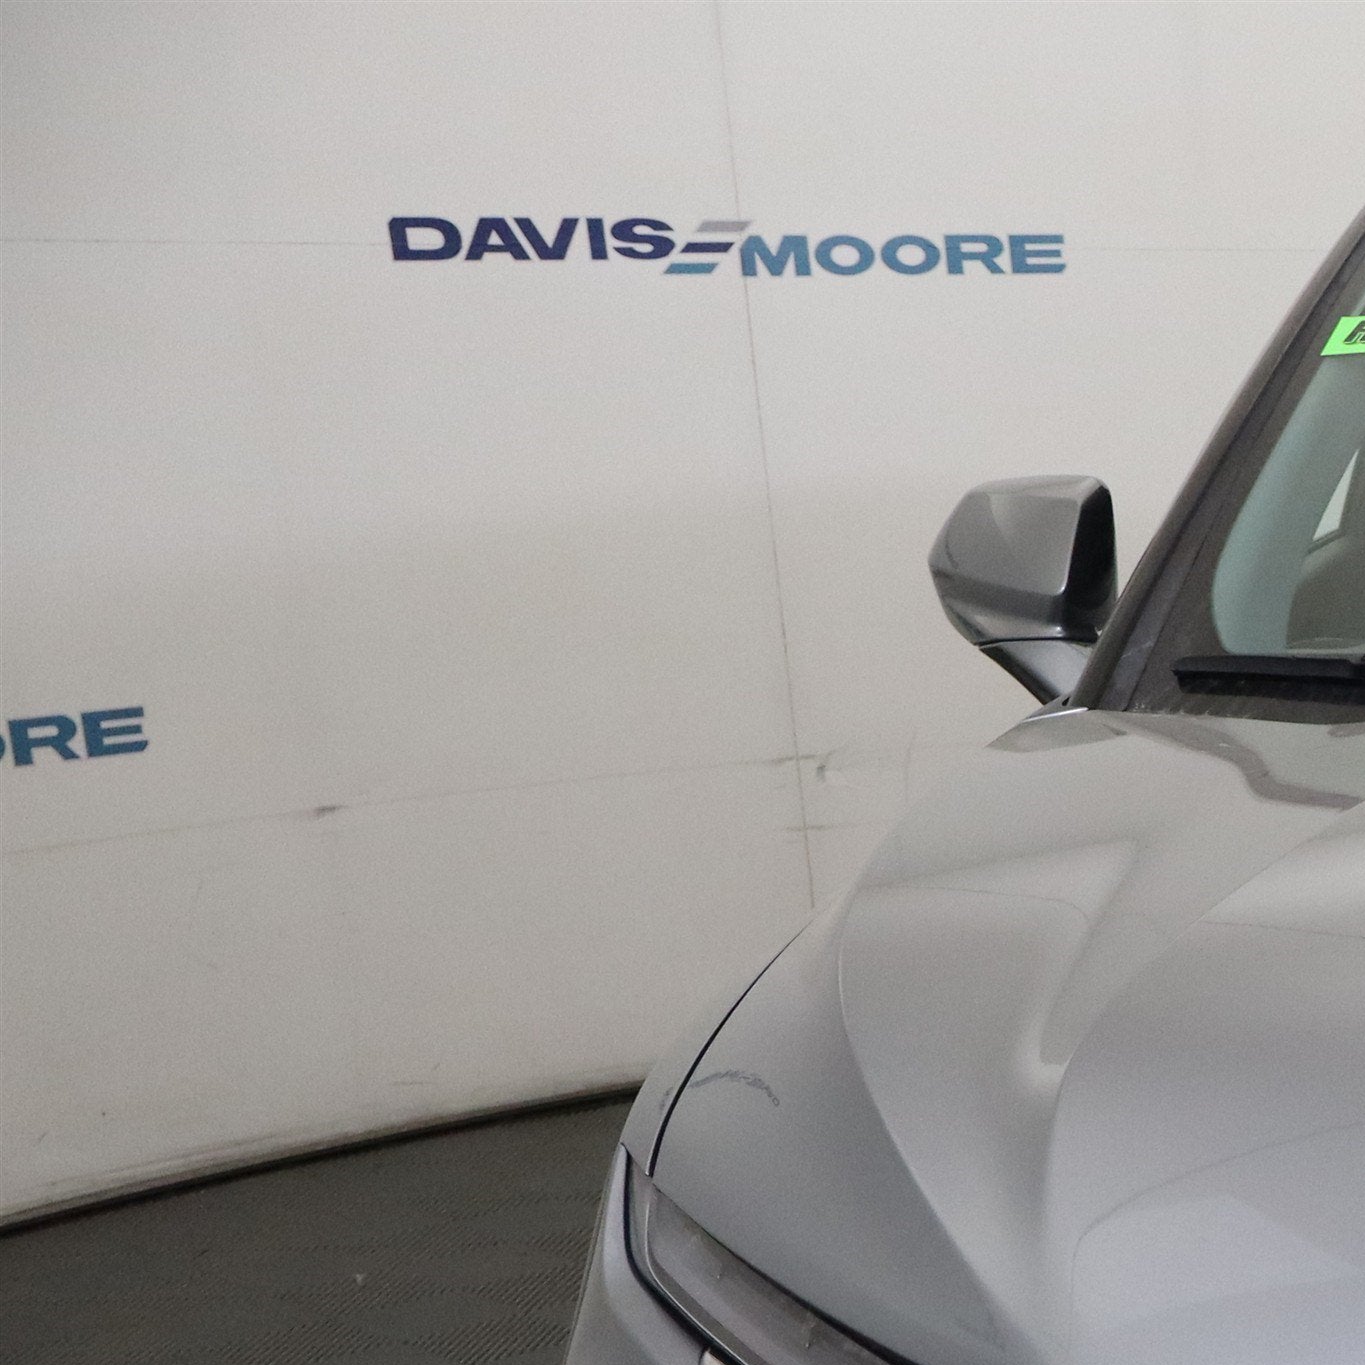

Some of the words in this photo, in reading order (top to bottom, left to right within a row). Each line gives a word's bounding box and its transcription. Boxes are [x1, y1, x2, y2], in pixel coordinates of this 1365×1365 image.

[388, 216, 676, 262] DAVIS
[737, 233, 1068, 277] MOORE
[0, 706, 149, 767] RE
